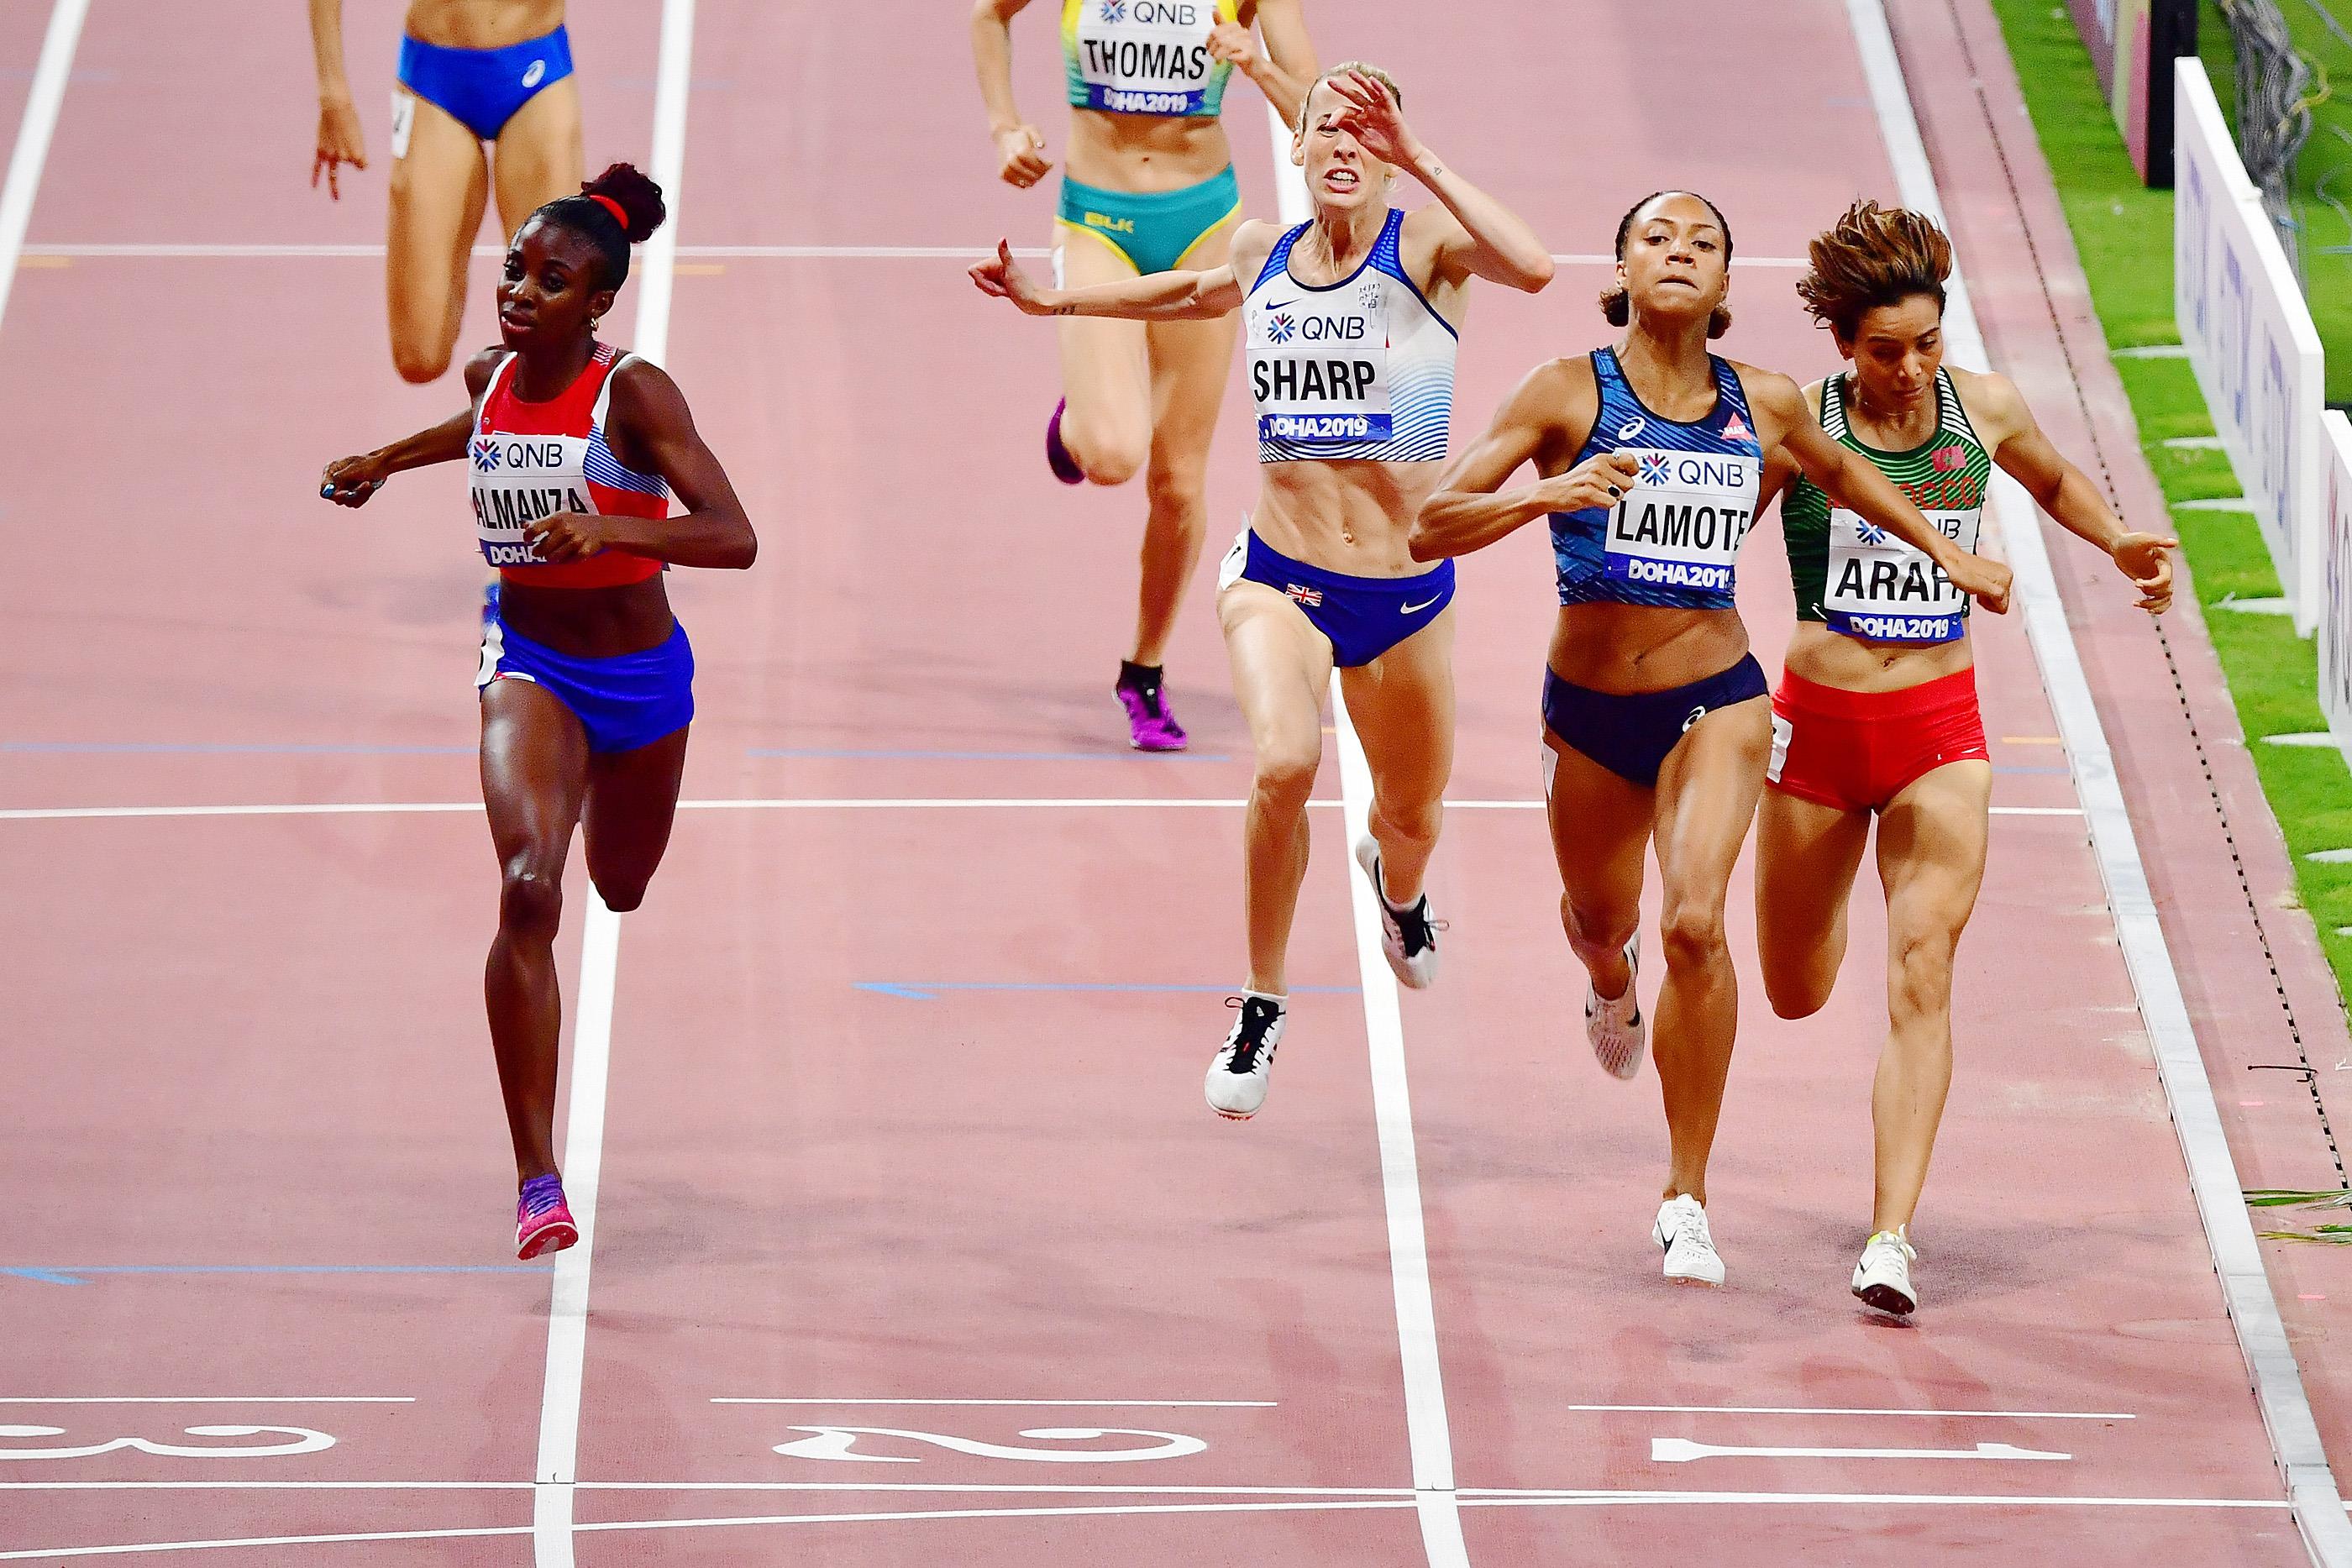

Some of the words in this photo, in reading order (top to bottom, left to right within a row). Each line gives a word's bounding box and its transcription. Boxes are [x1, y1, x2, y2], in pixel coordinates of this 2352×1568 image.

[1134, 1, 1196, 25] QNB
[1084, 39, 1207, 80] THOMAS
[1084, 212, 1135, 233] BLK
[1302, 316, 1365, 341] QNB
[1253, 359, 1376, 402] SHARP
[507, 443, 564, 469] QNB
[1678, 459, 1744, 487] QNB
[1850, 616, 1950, 639] DOHA2019
[771, 1424, 1209, 1463] 2
[1651, 1437, 2072, 1463] 1
